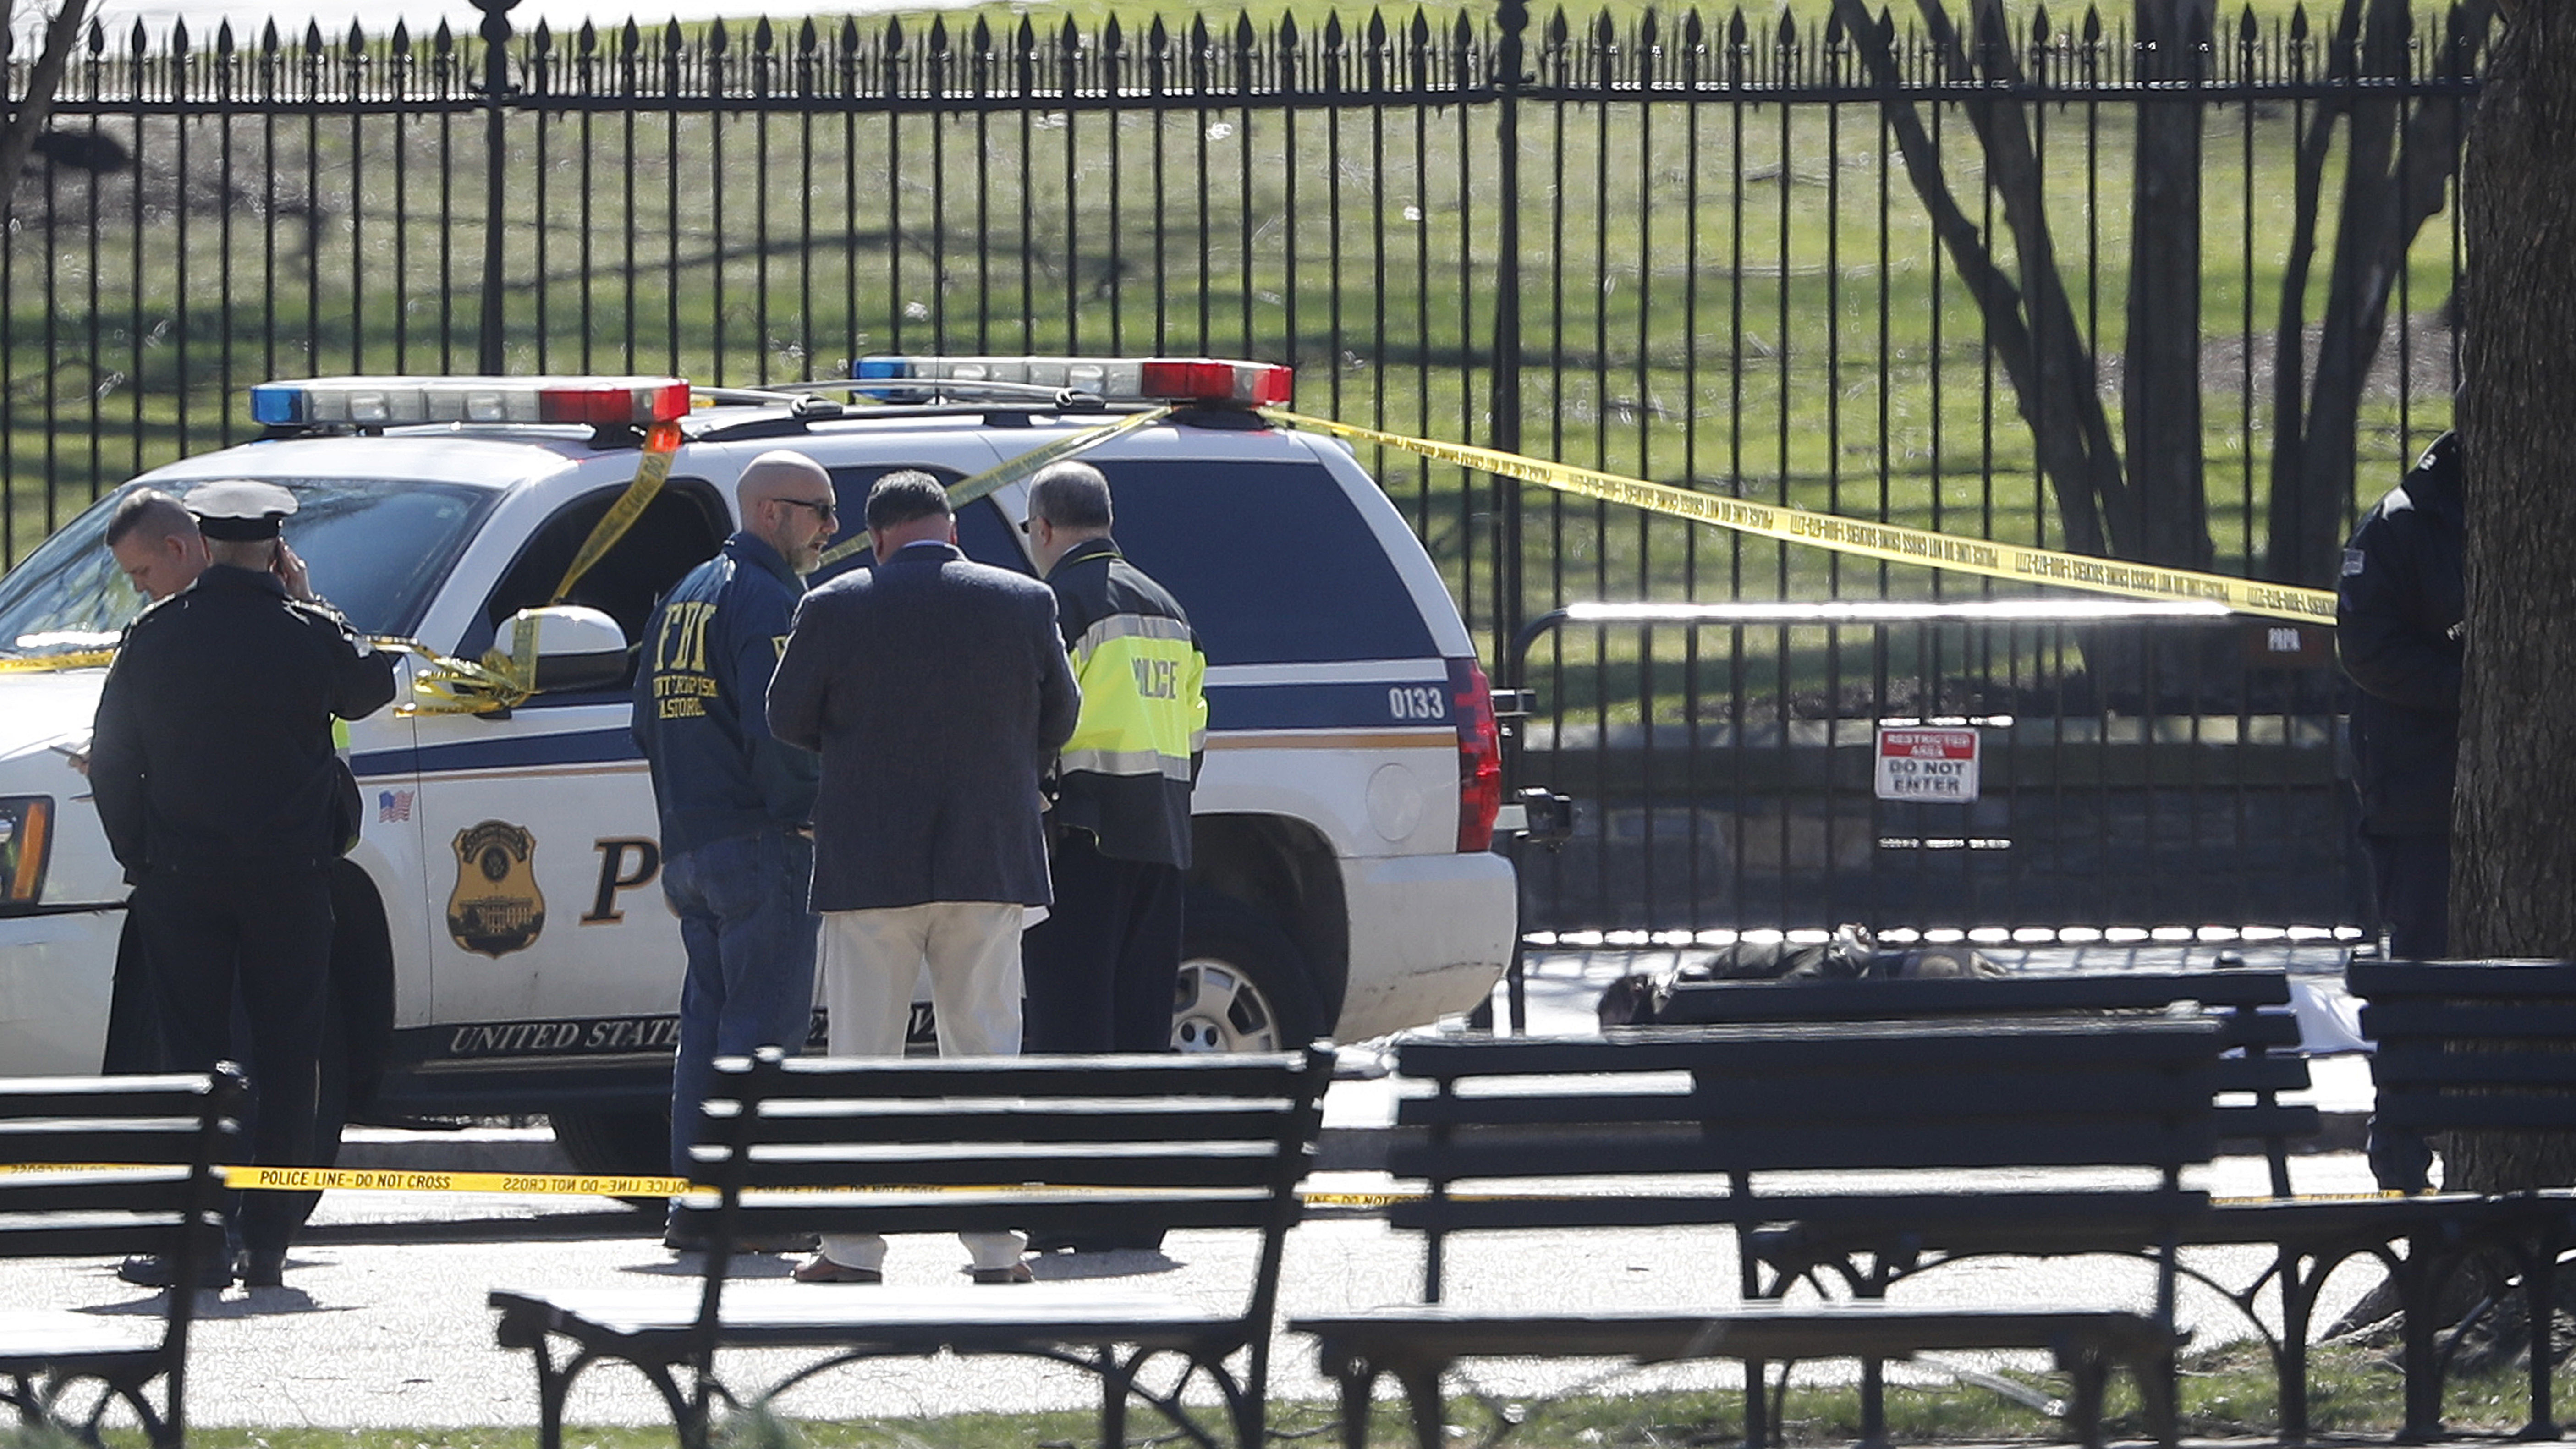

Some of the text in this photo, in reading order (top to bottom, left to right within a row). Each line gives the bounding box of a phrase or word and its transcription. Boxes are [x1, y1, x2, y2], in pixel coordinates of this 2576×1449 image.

[1388, 686, 1445, 719] 0133
[1889, 759, 1965, 776] DO NOT
[1892, 774, 1961, 795] ENTER
[450, 1018, 681, 1052] UNITED STATE
[260, 1170, 312, 1186] POLICE
[377, 1174, 404, 1188] NOT
[407, 1175, 451, 1189] CROSS
